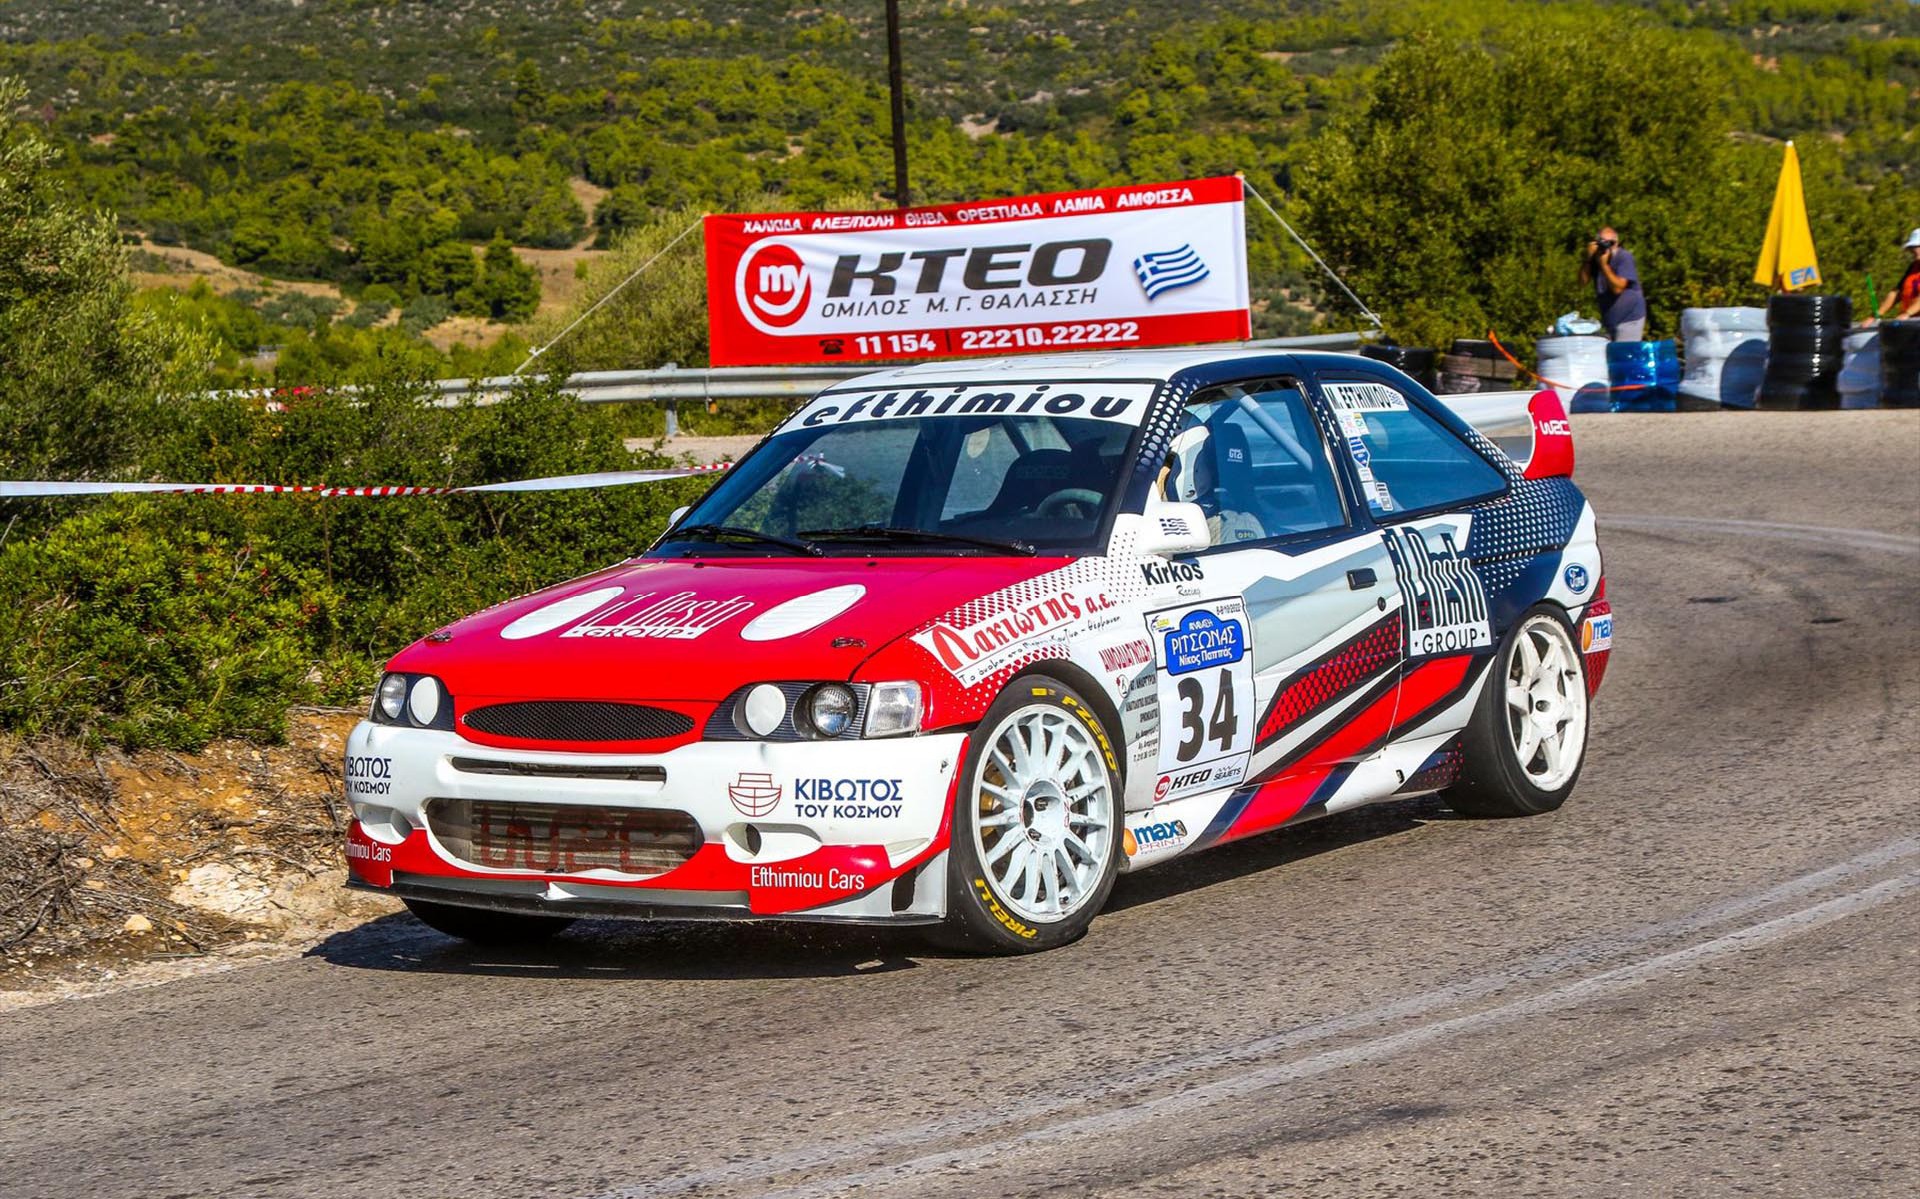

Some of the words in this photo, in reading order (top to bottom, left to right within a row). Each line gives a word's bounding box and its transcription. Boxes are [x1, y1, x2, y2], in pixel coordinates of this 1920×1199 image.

[743, 218, 803, 234] ΧΑΛΚΙΔΑ
[904, 211, 948, 226] ΘΗΒΑ
[956, 202, 1044, 222] ΟΡΕΣΤΙΑΔΑ
[1053, 195, 1105, 214] ΛΑΜΙΑ
[1116, 187, 1194, 208] ΑΜΦΙΣΣΑ
[826, 238, 1113, 298] ΚΤΕΟ
[820, 299, 910, 319] ΟΜΙΛΟΣ
[980, 287, 1098, 310] ΘΑΛΑΣΣΗ
[960, 320, 1140, 350] 22210.22222
[802, 385, 1134, 428] efthimiou
[1140, 561, 1204, 586] Kirkos
[584, 628, 684, 637] GROUP
[931, 591, 1082, 671] Λακιώτης
[1171, 625, 1237, 656] ΡΙΤΣΩΝΑΣ
[1422, 627, 1478, 654] GROUP
[1176, 667, 1238, 763] 34
[355, 782, 391, 795] ΚΟΣΜΟΥ
[794, 778, 903, 802] ΚΙΒΩΤΟΣ
[794, 804, 828, 818] ΤΟΥ
[833, 804, 903, 819] ΚΟΣΜΟΥ
[371, 841, 392, 863] Cars
[751, 865, 823, 889] Efthimiou
[828, 868, 865, 890] Cars
[974, 878, 1038, 939] PIRELLI
